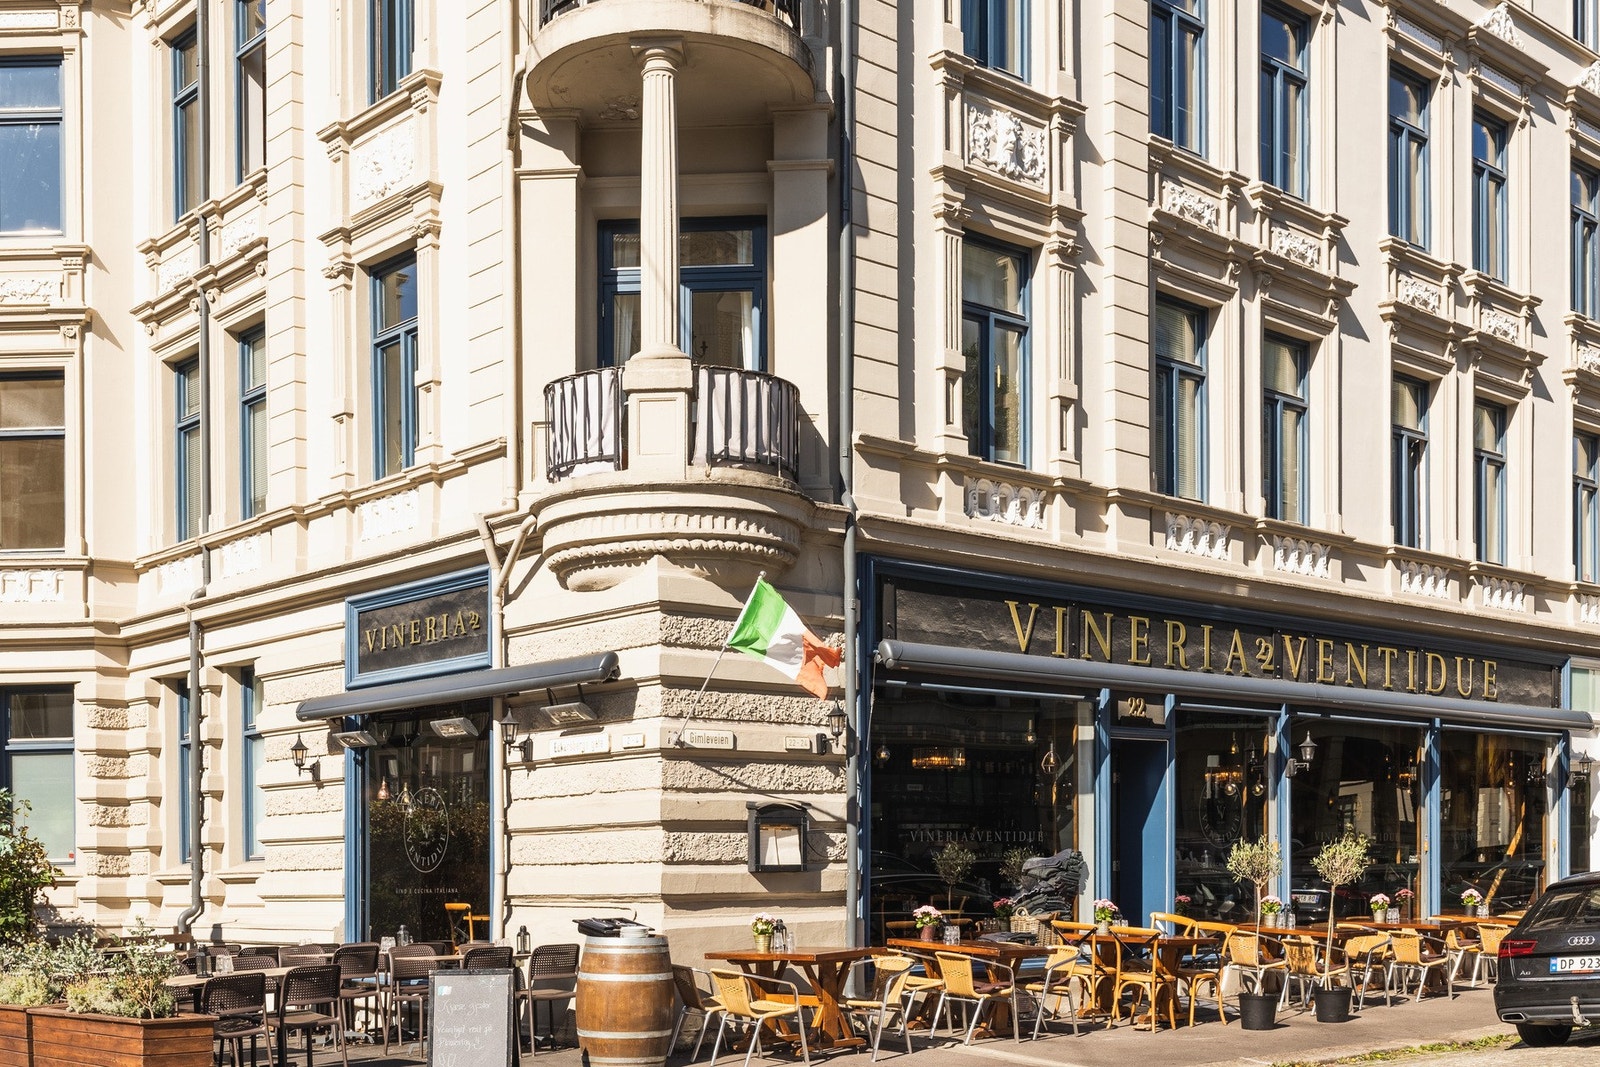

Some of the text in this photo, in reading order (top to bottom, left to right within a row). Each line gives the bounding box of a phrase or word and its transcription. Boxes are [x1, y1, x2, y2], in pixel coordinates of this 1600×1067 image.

[365, 610, 467, 653] VINERIA
[1004, 600, 1252, 675] VINERIA
[1281, 634, 1498, 699] VENTIDUE
[1127, 697, 1146, 718] 22
[689, 732, 729, 745] Gimleveien
[787, 739, 809, 748] 22-24
[909, 830, 968, 843] VINERIA
[977, 830, 1045, 843] VENTIDUE
[1560, 958, 1575, 970] DP
